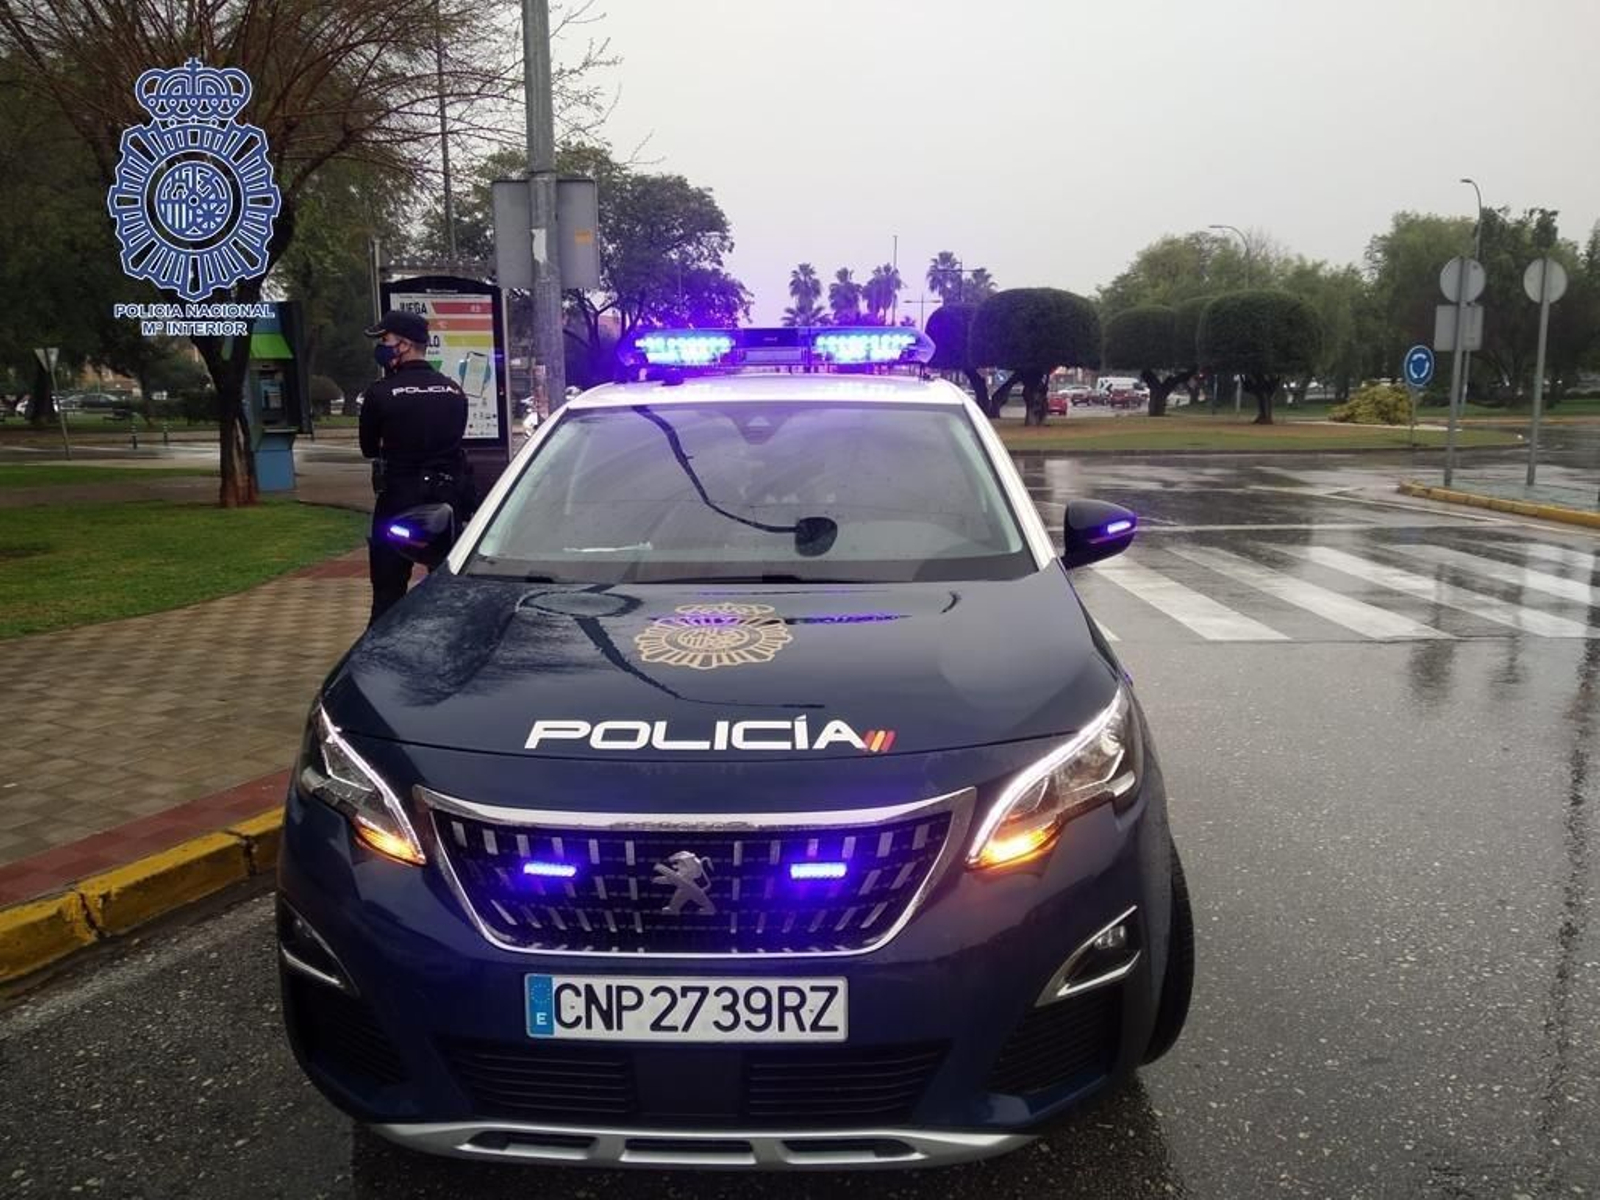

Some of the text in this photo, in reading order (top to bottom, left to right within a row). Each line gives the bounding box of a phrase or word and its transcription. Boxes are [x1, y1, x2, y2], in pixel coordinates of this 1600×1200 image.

[524, 714, 866, 751] POLICÍA
[536, 983, 840, 1033] E CNP2739RZ
